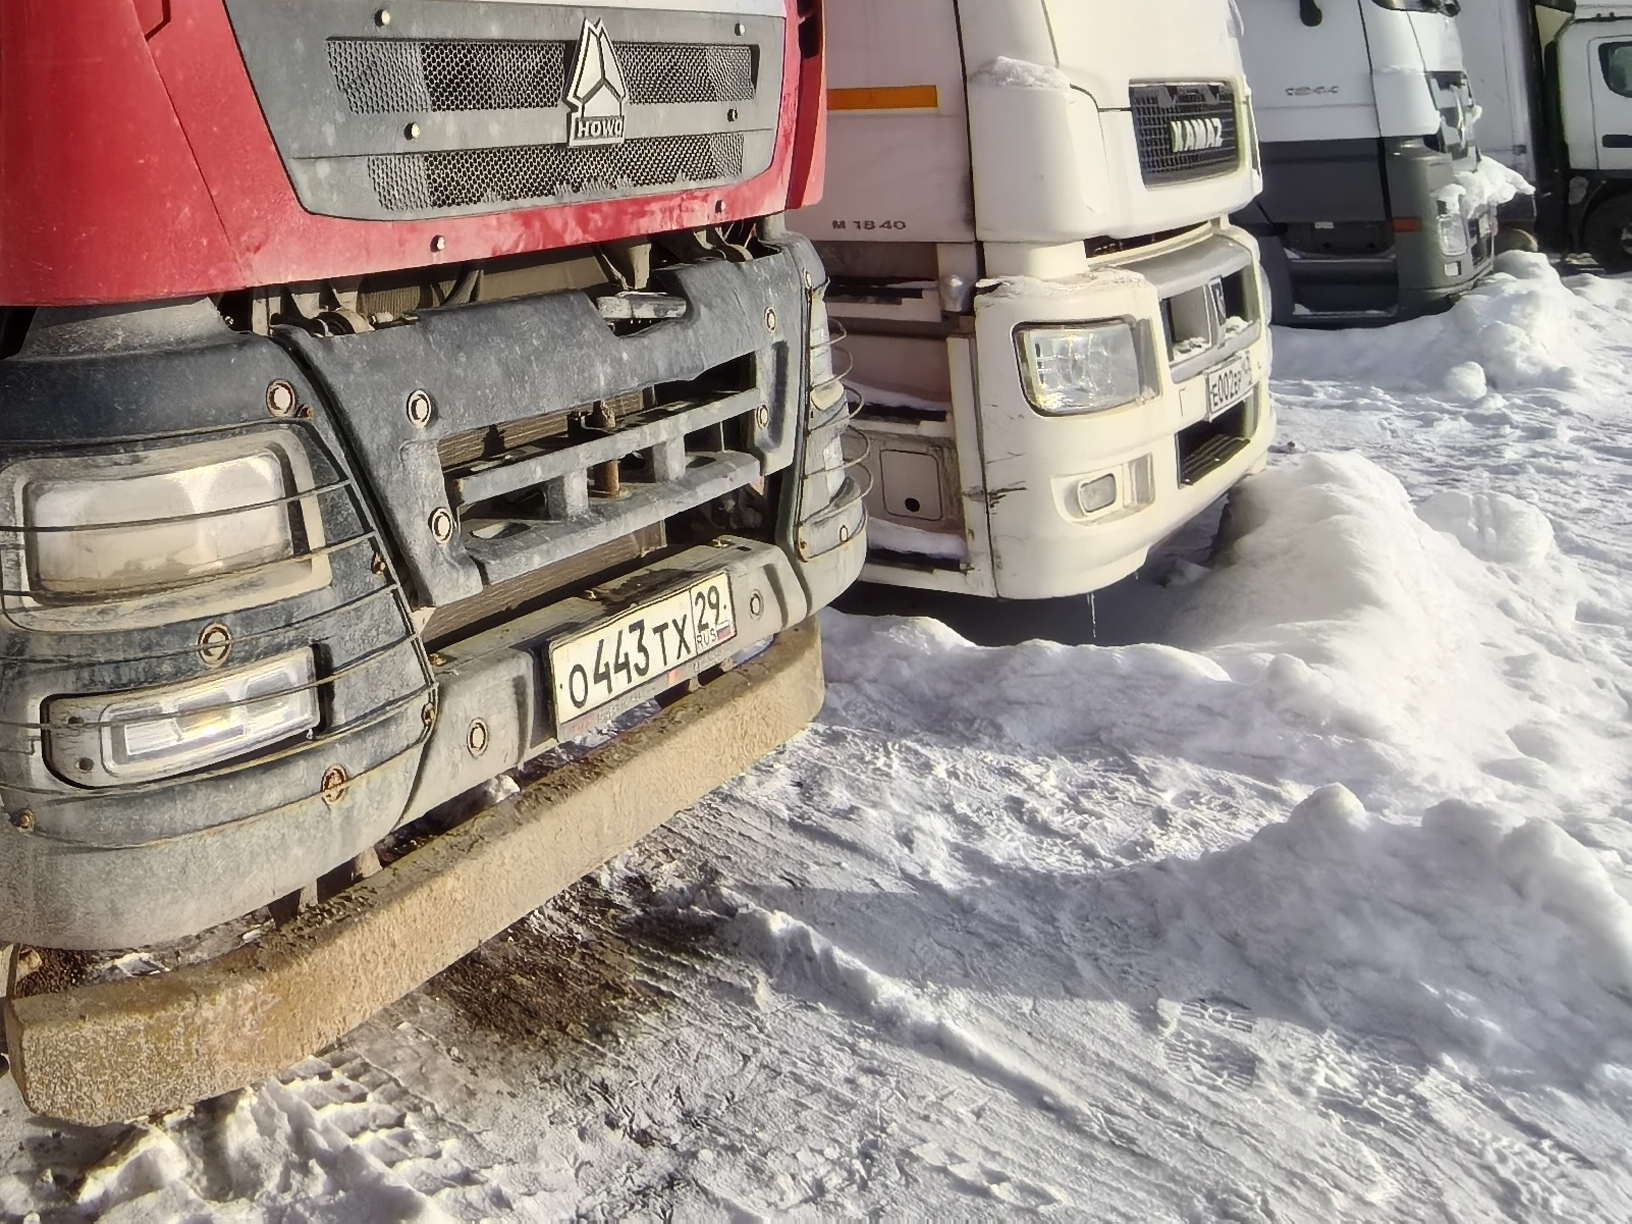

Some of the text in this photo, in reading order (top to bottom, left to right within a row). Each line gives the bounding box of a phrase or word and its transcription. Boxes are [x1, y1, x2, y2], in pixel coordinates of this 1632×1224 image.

[578, 119, 623, 138] HOWO
[832, 219, 906, 231] M 1840
[694, 585, 720, 634] 29
[696, 627, 717, 648] RUS
